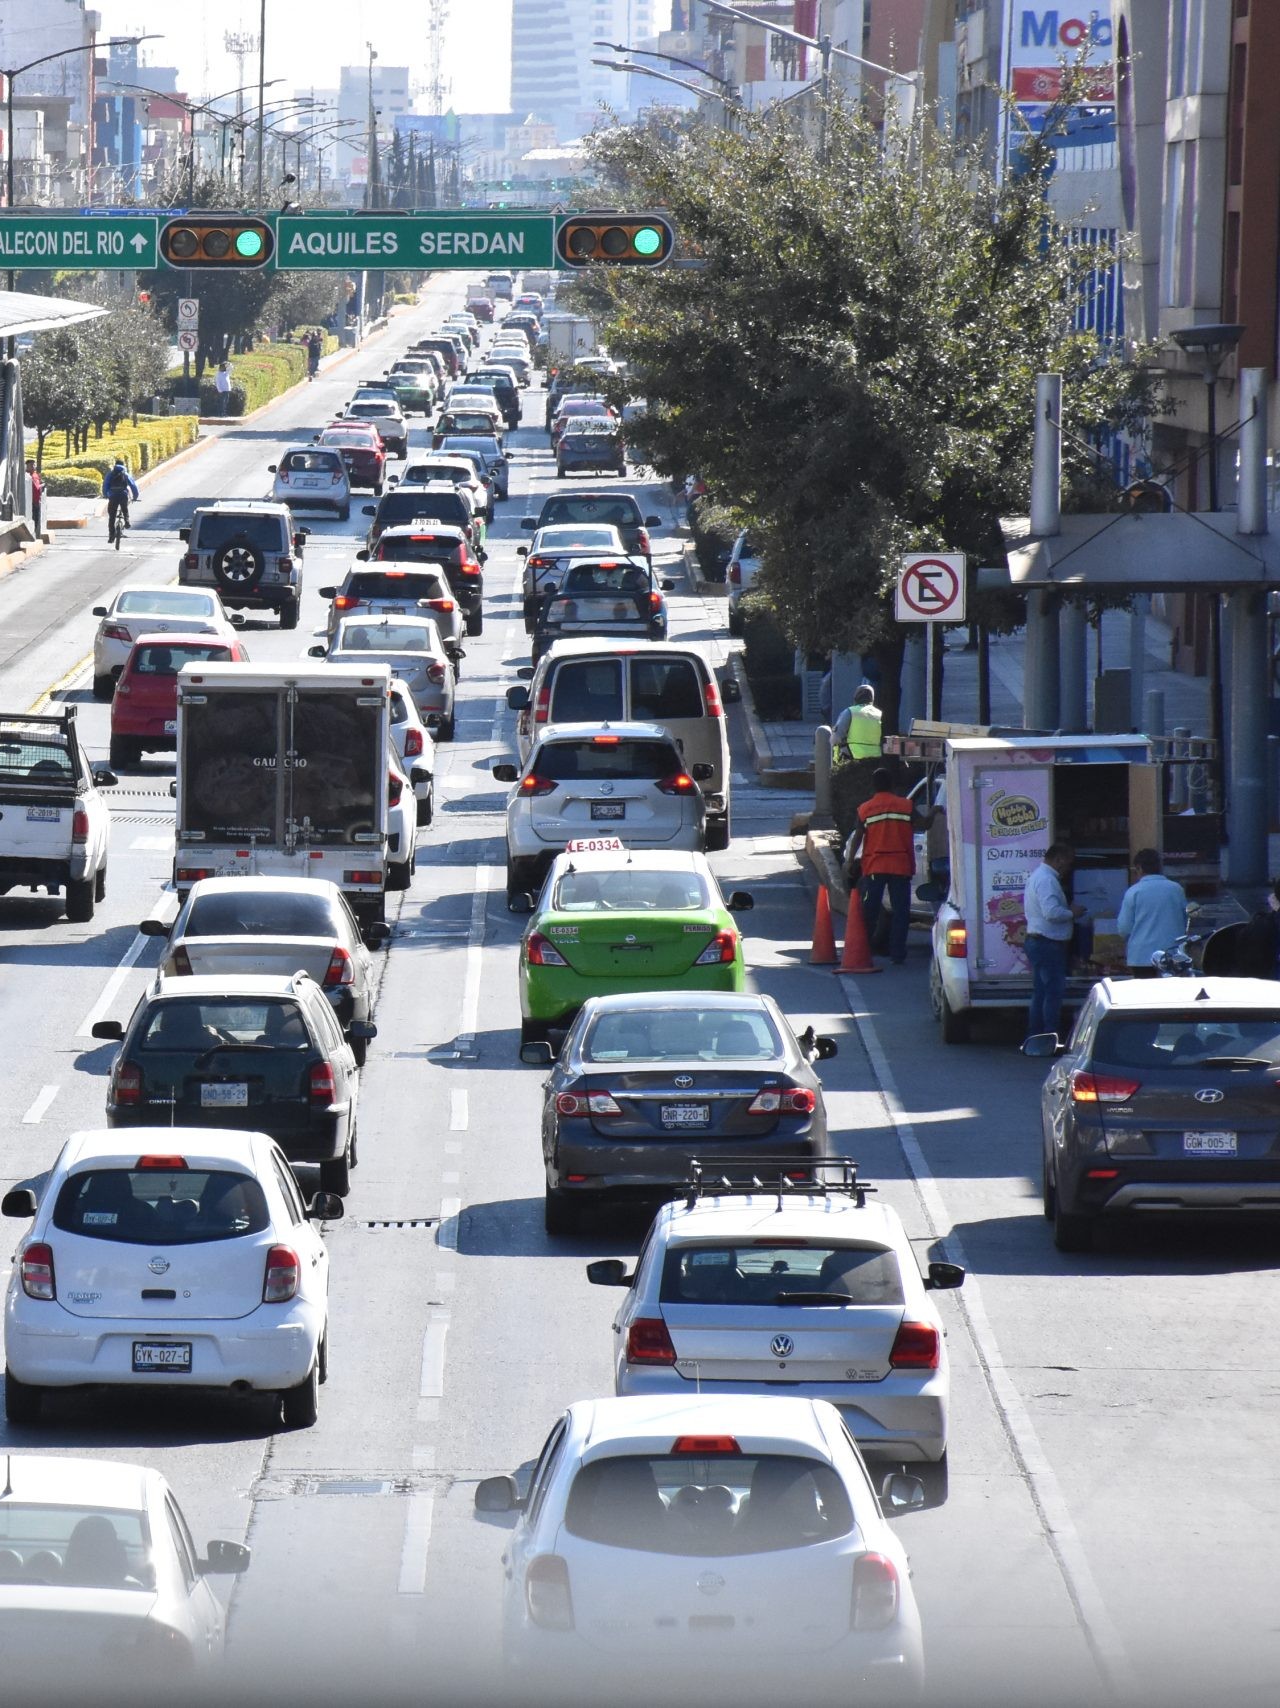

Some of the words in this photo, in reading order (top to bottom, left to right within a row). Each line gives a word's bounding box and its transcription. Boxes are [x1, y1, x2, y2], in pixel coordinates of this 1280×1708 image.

[62, 231, 94, 255] DEL
[97, 231, 124, 255] RIO
[288, 232, 399, 256] AQUILES
[419, 232, 524, 254] SERDAN
[569, 840, 620, 852] LE-0334
[135, 1349, 189, 1363] GYK-027-C
